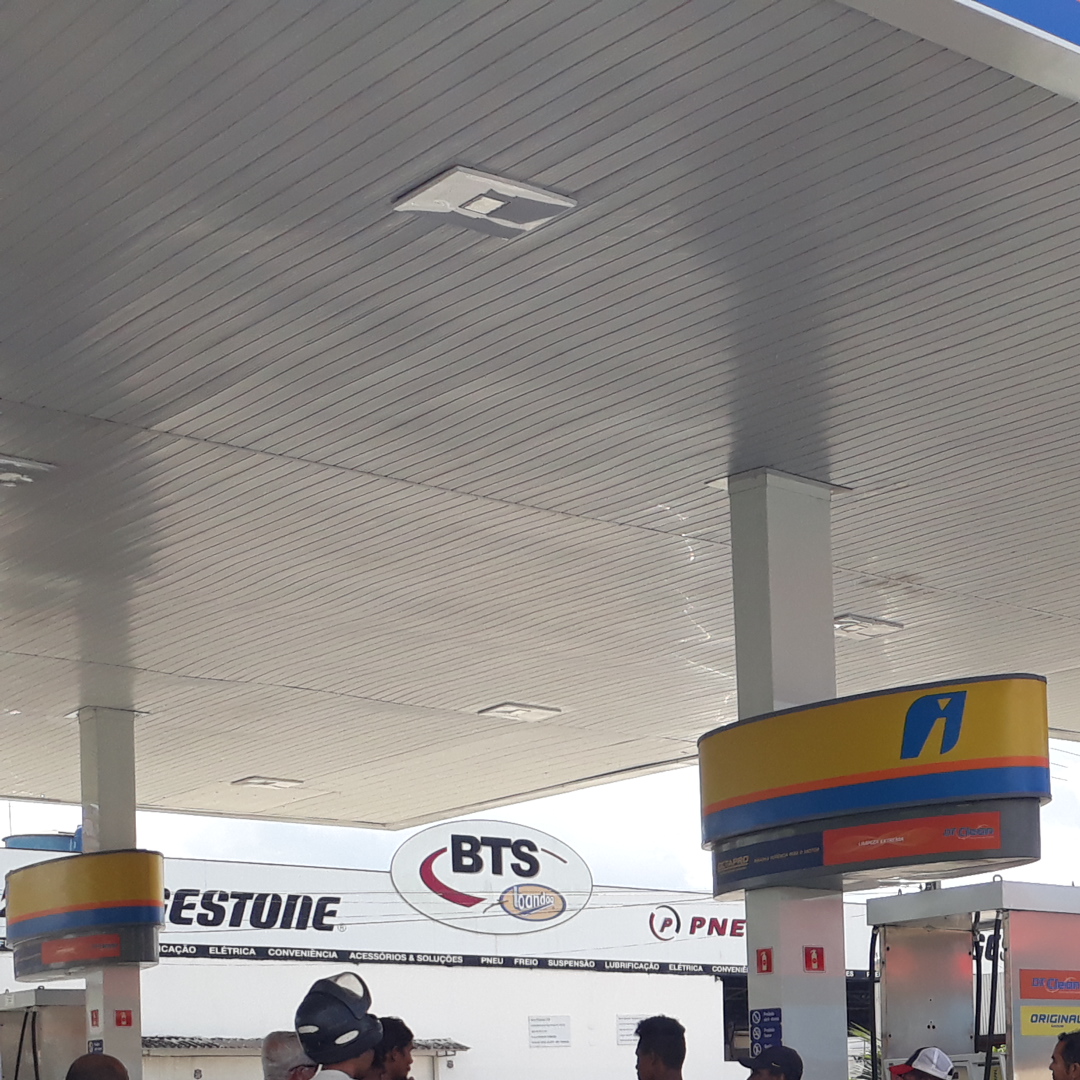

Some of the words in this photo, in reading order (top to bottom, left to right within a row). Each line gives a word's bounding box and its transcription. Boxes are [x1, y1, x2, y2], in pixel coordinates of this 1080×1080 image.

[450, 834, 541, 878] BTS
[689, 916, 747, 937] PNE
[209, 945, 256, 956] ELÉTRICA
[268, 947, 338, 959] CONVENIÊNCIA
[349, 950, 407, 962] ACESSÓRIOS
[409, 953, 415, 961] &
[417, 952, 463, 964] SOLUÇÕES
[481, 957, 504, 965] PNEU
[514, 958, 538, 966] FREIO
[548, 958, 595, 968] SUSPENSÃO
[604, 960, 660, 971] LUBRIFICAÇÃO
[669, 962, 703, 972] ELÉTRICA
